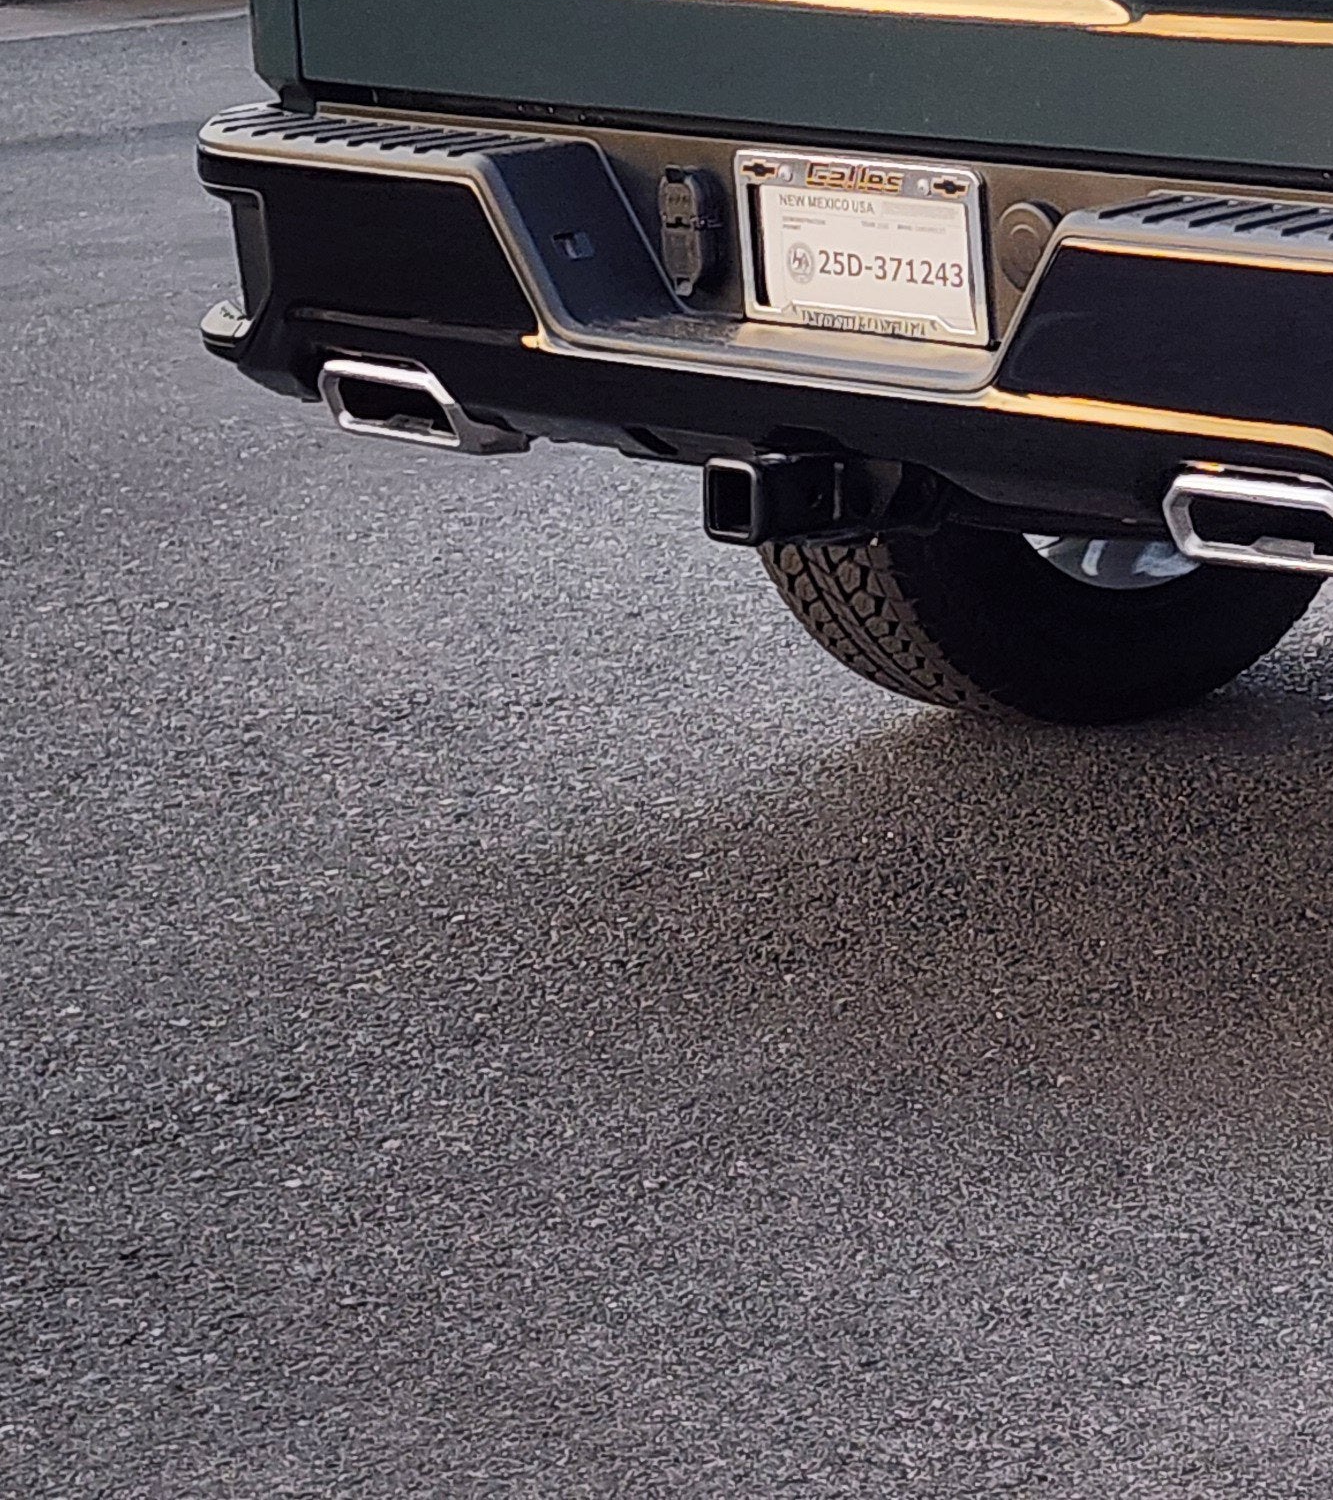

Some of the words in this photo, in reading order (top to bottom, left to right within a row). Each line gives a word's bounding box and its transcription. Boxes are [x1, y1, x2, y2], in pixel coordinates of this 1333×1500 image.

[779, 194, 805, 208] NEW
[808, 195, 850, 212] MEXICO
[852, 201, 876, 215] USA
[819, 249, 964, 288] 25D-371243
